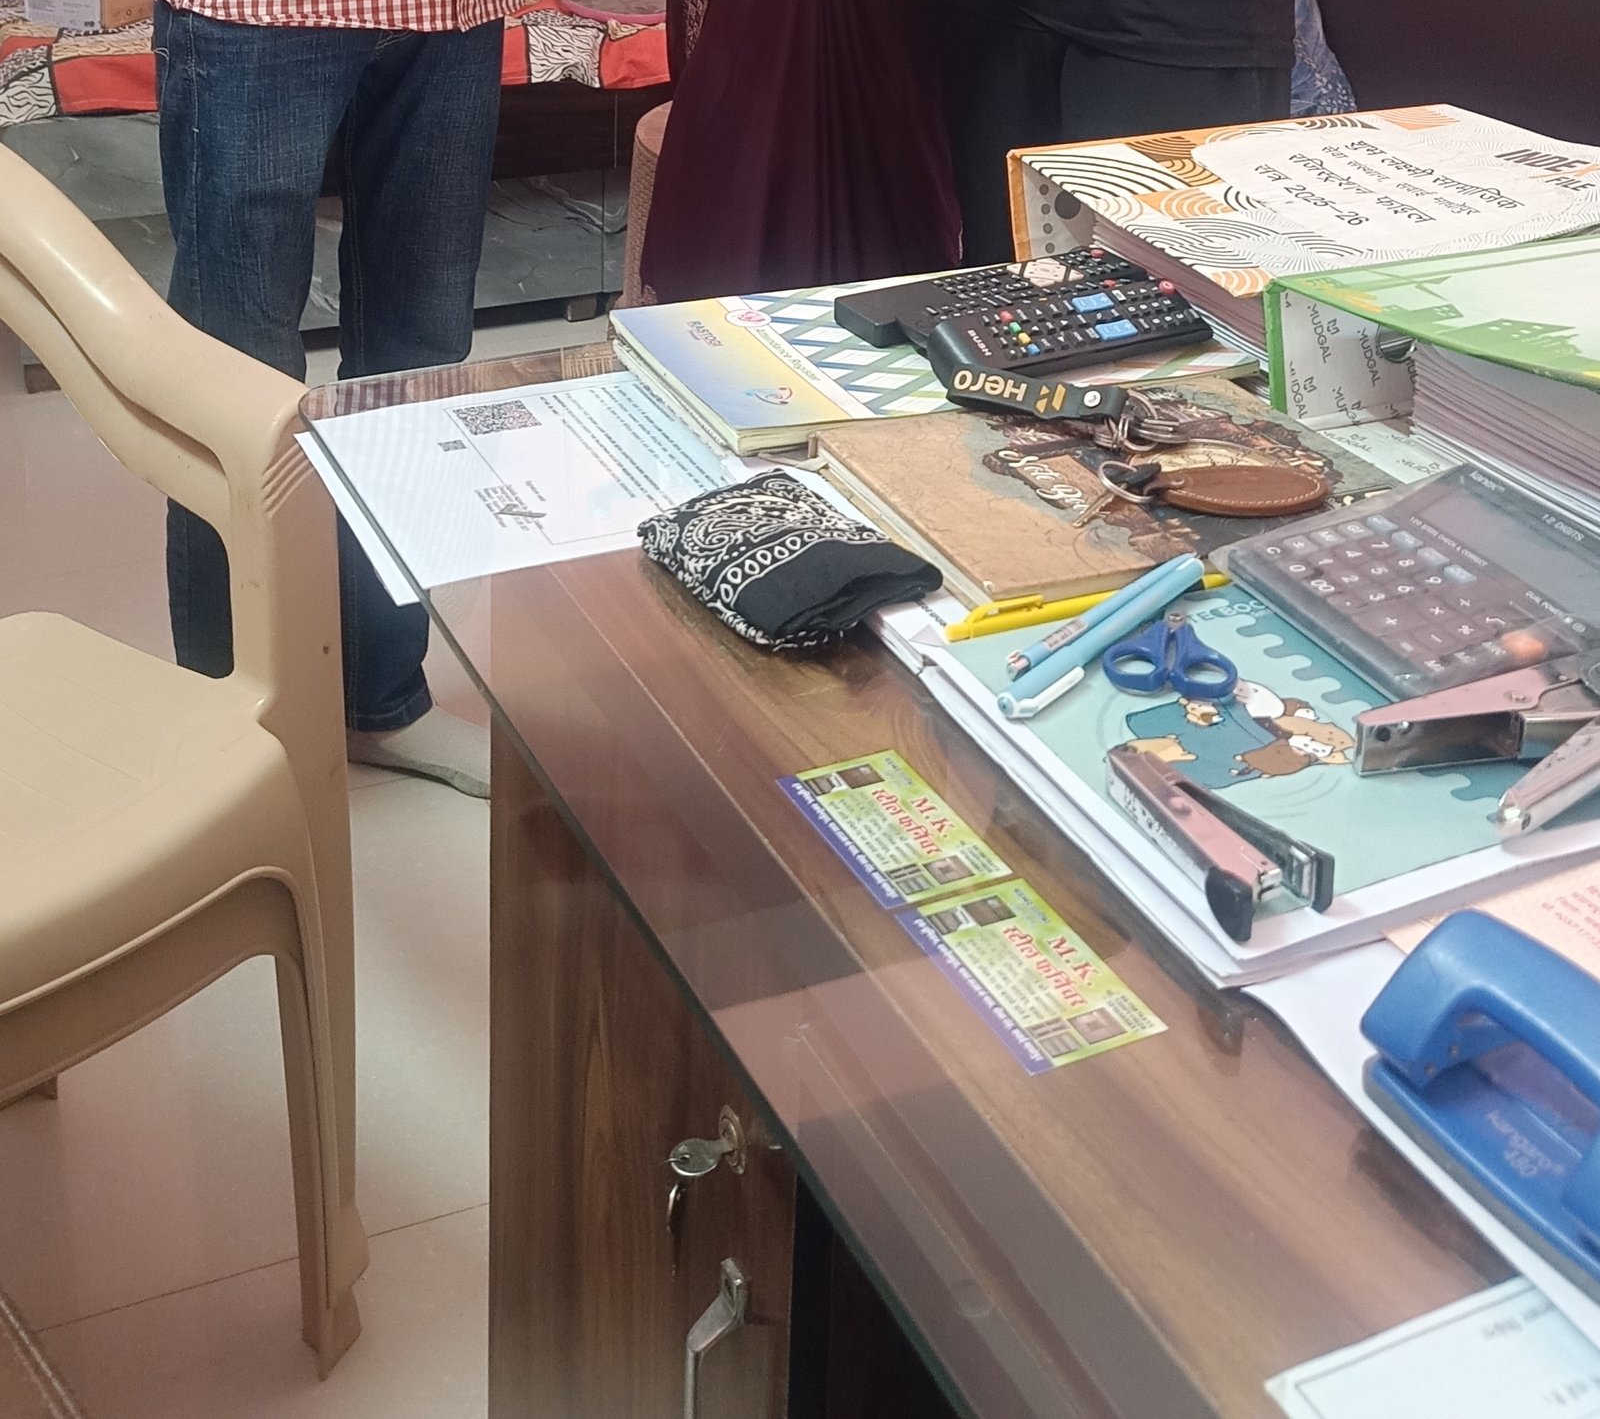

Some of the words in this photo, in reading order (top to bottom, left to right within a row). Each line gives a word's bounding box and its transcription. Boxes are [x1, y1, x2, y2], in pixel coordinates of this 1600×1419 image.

[1345, 140, 1387, 159] शुभ
[1432, 174, 1526, 210] सामाजिक
[1544, 176, 1596, 192] FILE
[687, 320, 724, 348] RASTOGI
[967, 329, 992, 357] BUSH
[1307, 302, 1333, 364] MUDGAL
[1357, 326, 1382, 387] MUDGAL
[954, 369, 1027, 402] Hero
[871, 788, 906, 816] स्टील
[1003, 925, 1044, 959] स्टील
